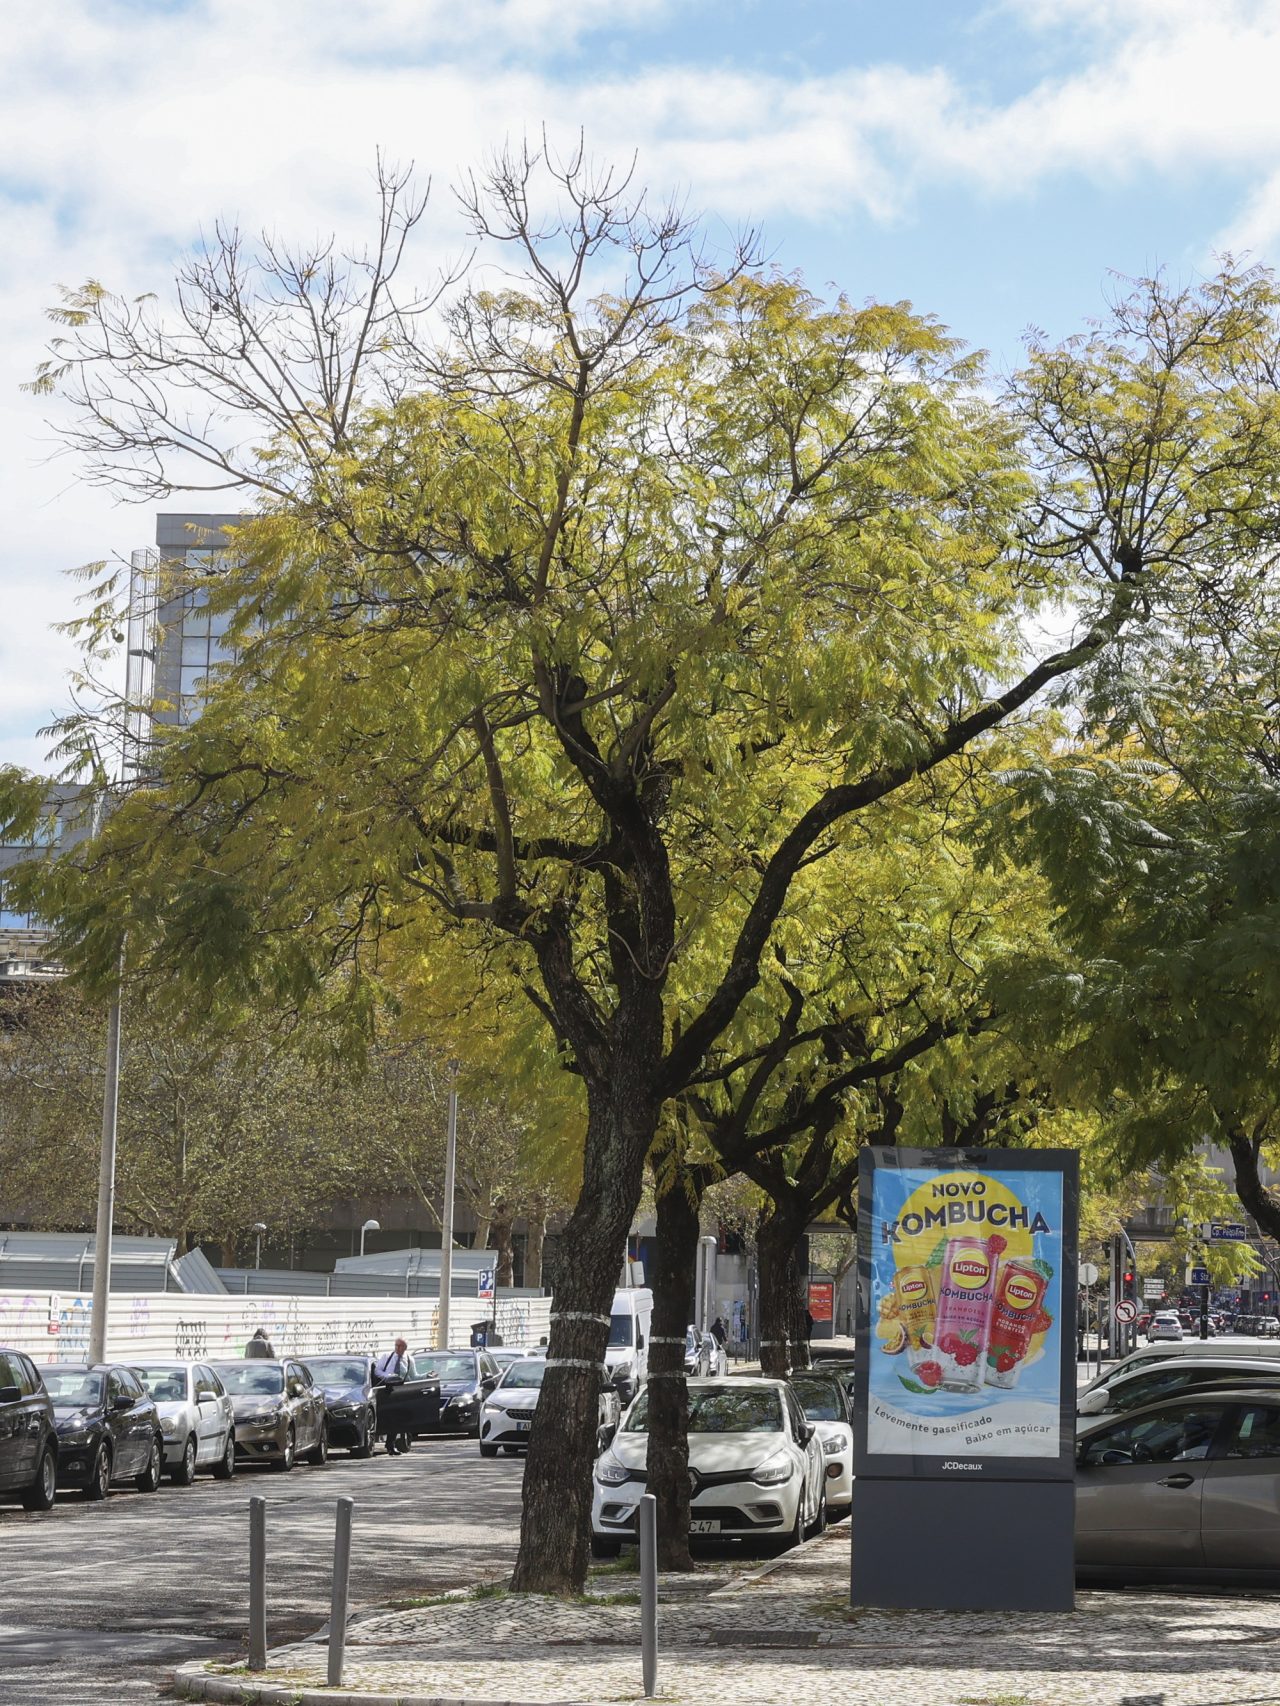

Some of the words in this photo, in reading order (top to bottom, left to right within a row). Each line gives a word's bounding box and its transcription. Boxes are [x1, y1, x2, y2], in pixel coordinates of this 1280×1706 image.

[932, 1180, 987, 1198] NOVO
[881, 1200, 1051, 1245] KOMBUCHA
[954, 1262, 986, 1276] Lipton
[481, 1273, 487, 1286] P
[903, 1282, 924, 1292] Lipton
[1009, 1286, 1033, 1299] Lipton
[477, 1333, 483, 1342] P
[874, 1406, 929, 1433] Levemente
[932, 1416, 993, 1436] gaseificado
[965, 1431, 993, 1445] Baixo
[996, 1426, 1012, 1437] em
[1014, 1423, 1052, 1435] açúcar
[942, 1461, 983, 1471] JCDecaux
